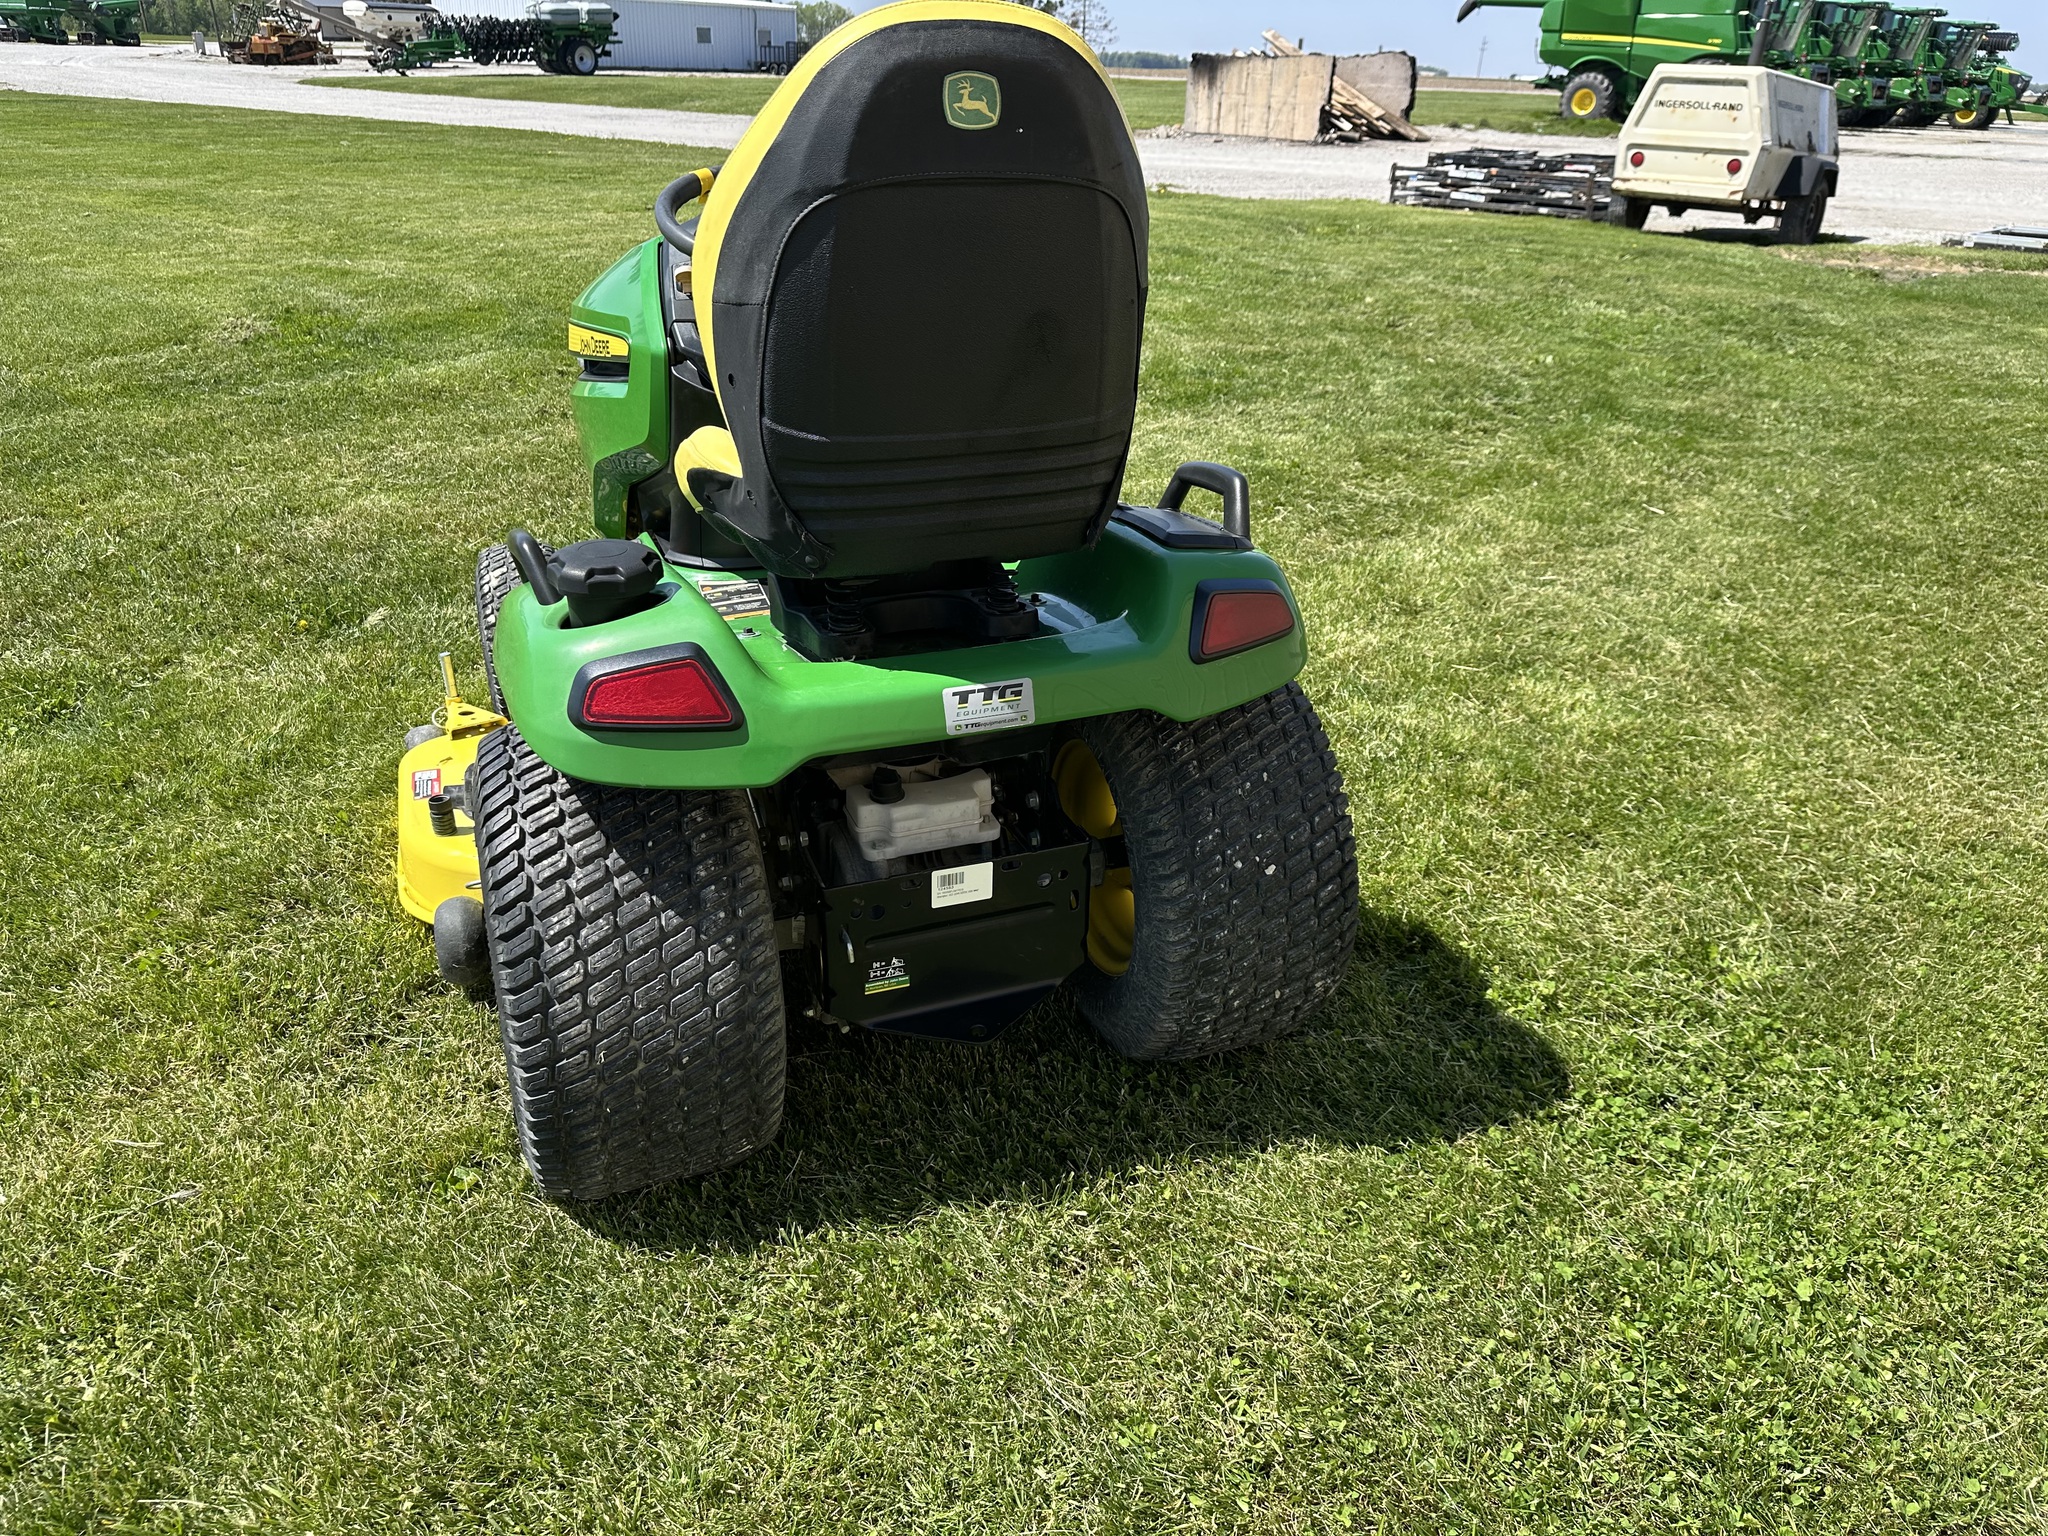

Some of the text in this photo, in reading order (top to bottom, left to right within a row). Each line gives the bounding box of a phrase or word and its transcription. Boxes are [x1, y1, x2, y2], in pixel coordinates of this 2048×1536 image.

[1654, 99, 1744, 112] INGERSOLL-RAND
[591, 336, 610, 355] DEERE
[952, 683, 1024, 709] TTG
[956, 703, 1021, 717] EQUIPMENT
[964, 717, 1019, 729] TTGequipment.com
